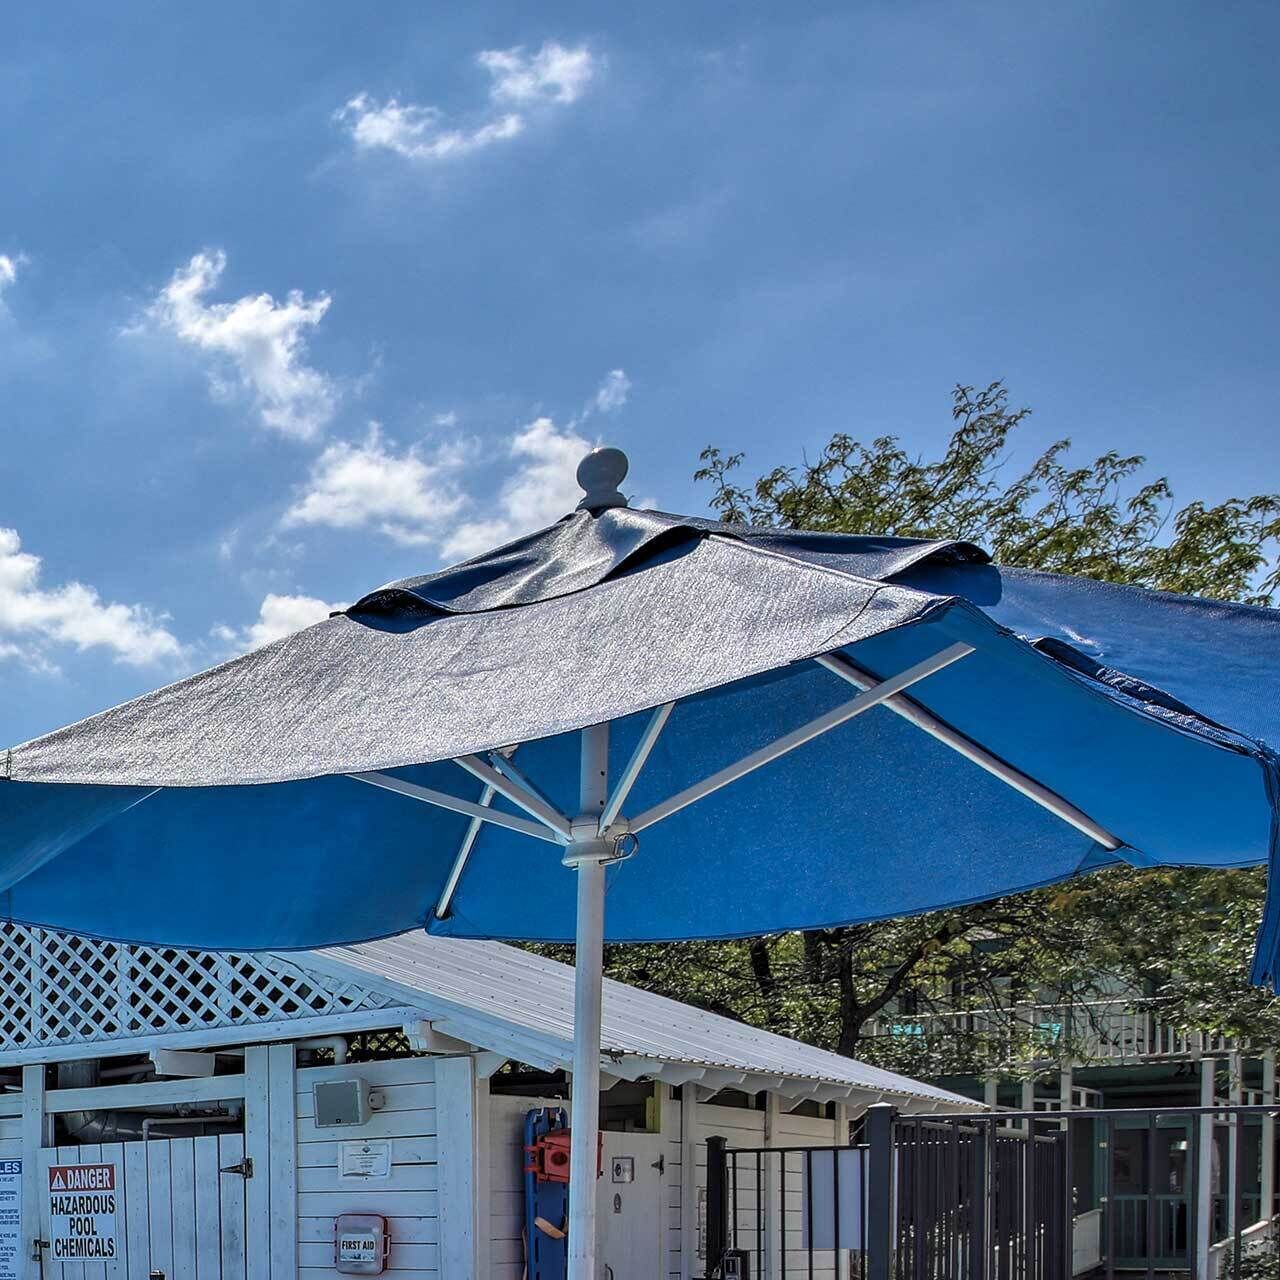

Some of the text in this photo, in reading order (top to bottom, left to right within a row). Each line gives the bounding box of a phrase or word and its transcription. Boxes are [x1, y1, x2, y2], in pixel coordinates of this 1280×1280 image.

[67, 1168, 111, 1189] DANGER
[51, 1195, 115, 1215] HAZARDOUS
[69, 1217, 97, 1236] POOL
[54, 1238, 115, 1257] CHEMICALS
[342, 1241, 375, 1250] FIRST AID
